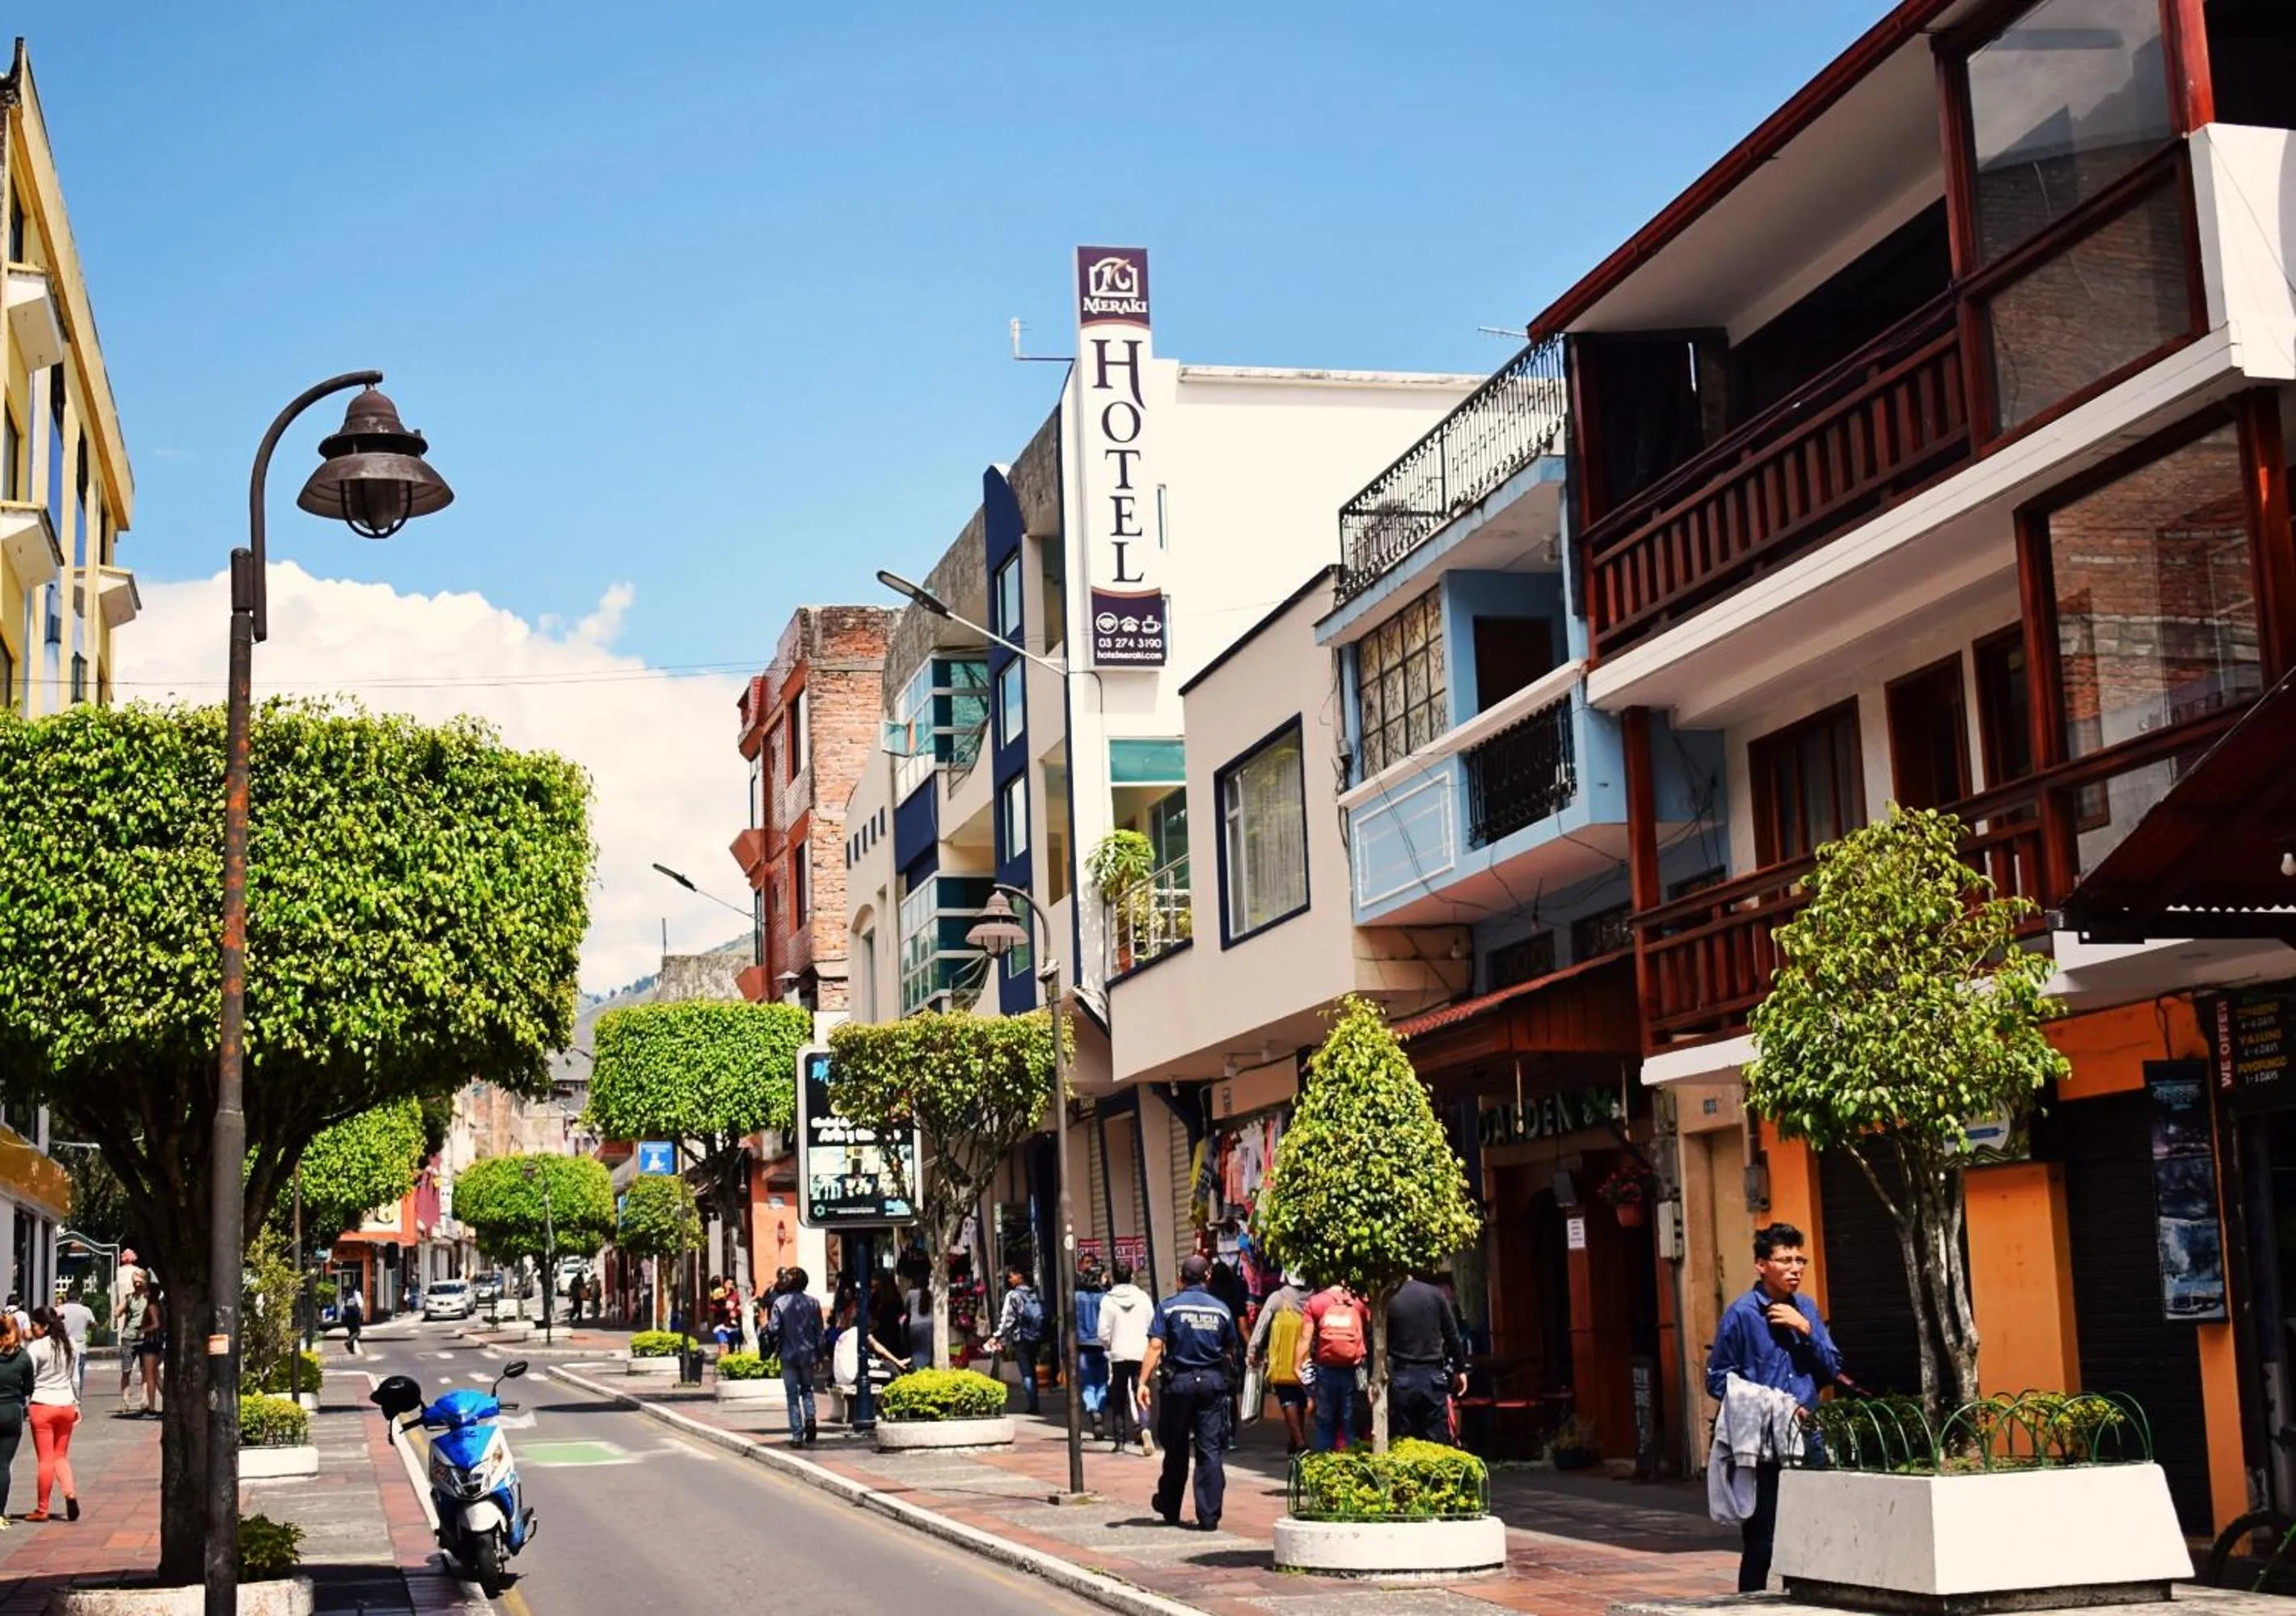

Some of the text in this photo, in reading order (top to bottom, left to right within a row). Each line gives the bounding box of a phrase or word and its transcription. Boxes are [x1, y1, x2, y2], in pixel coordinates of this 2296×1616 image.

[1083, 297, 1147, 314] MERAKI
[1090, 339, 1146, 584] HOTEL
[1099, 638, 1162, 648] 03 274 3190
[2216, 1000, 2233, 1088] WE OFFER
